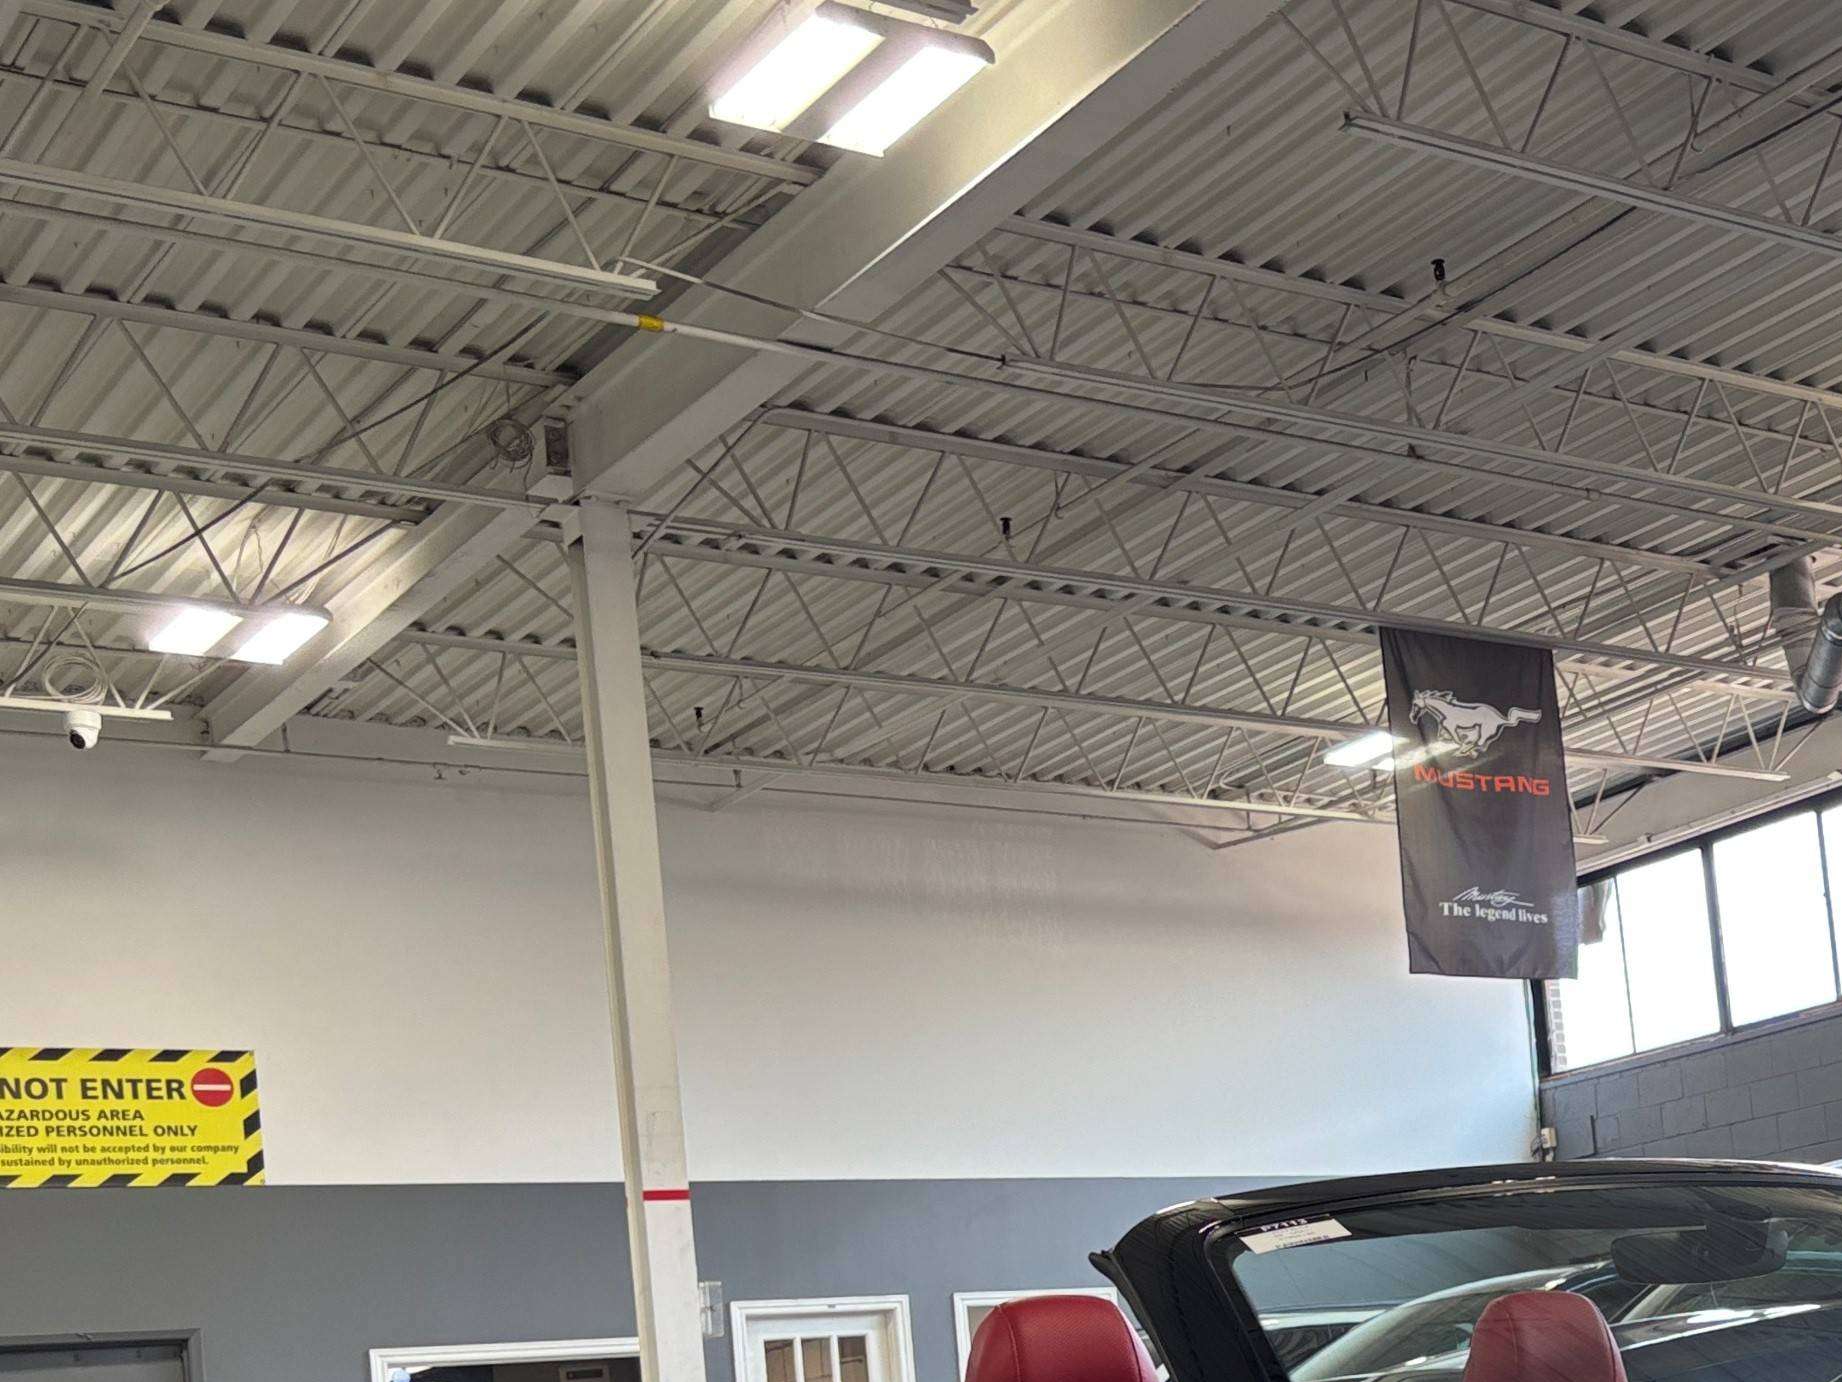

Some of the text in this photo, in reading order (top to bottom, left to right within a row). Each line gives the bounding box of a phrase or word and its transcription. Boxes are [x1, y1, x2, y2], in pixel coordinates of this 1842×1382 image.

[1413, 763, 1550, 795] MUSTANG
[1439, 901, 1549, 924] The legend lives
[0, 1077, 187, 1100] NOT ENTER
[97, 1109, 145, 1121] AREA
[45, 1125, 149, 1137] PERSONNEL
[153, 1125, 198, 1137] ONLY
[37, 1144, 57, 1153] will
[61, 1145, 80, 1153] not
[83, 1144, 98, 1153] be
[101, 1144, 149, 1155] accepted
[153, 1143, 166, 1154] by
[169, 1145, 188, 1153] our
[191, 1145, 239, 1155] company
[1, 1156, 209, 1168] sustained by unauthorized personnel.
